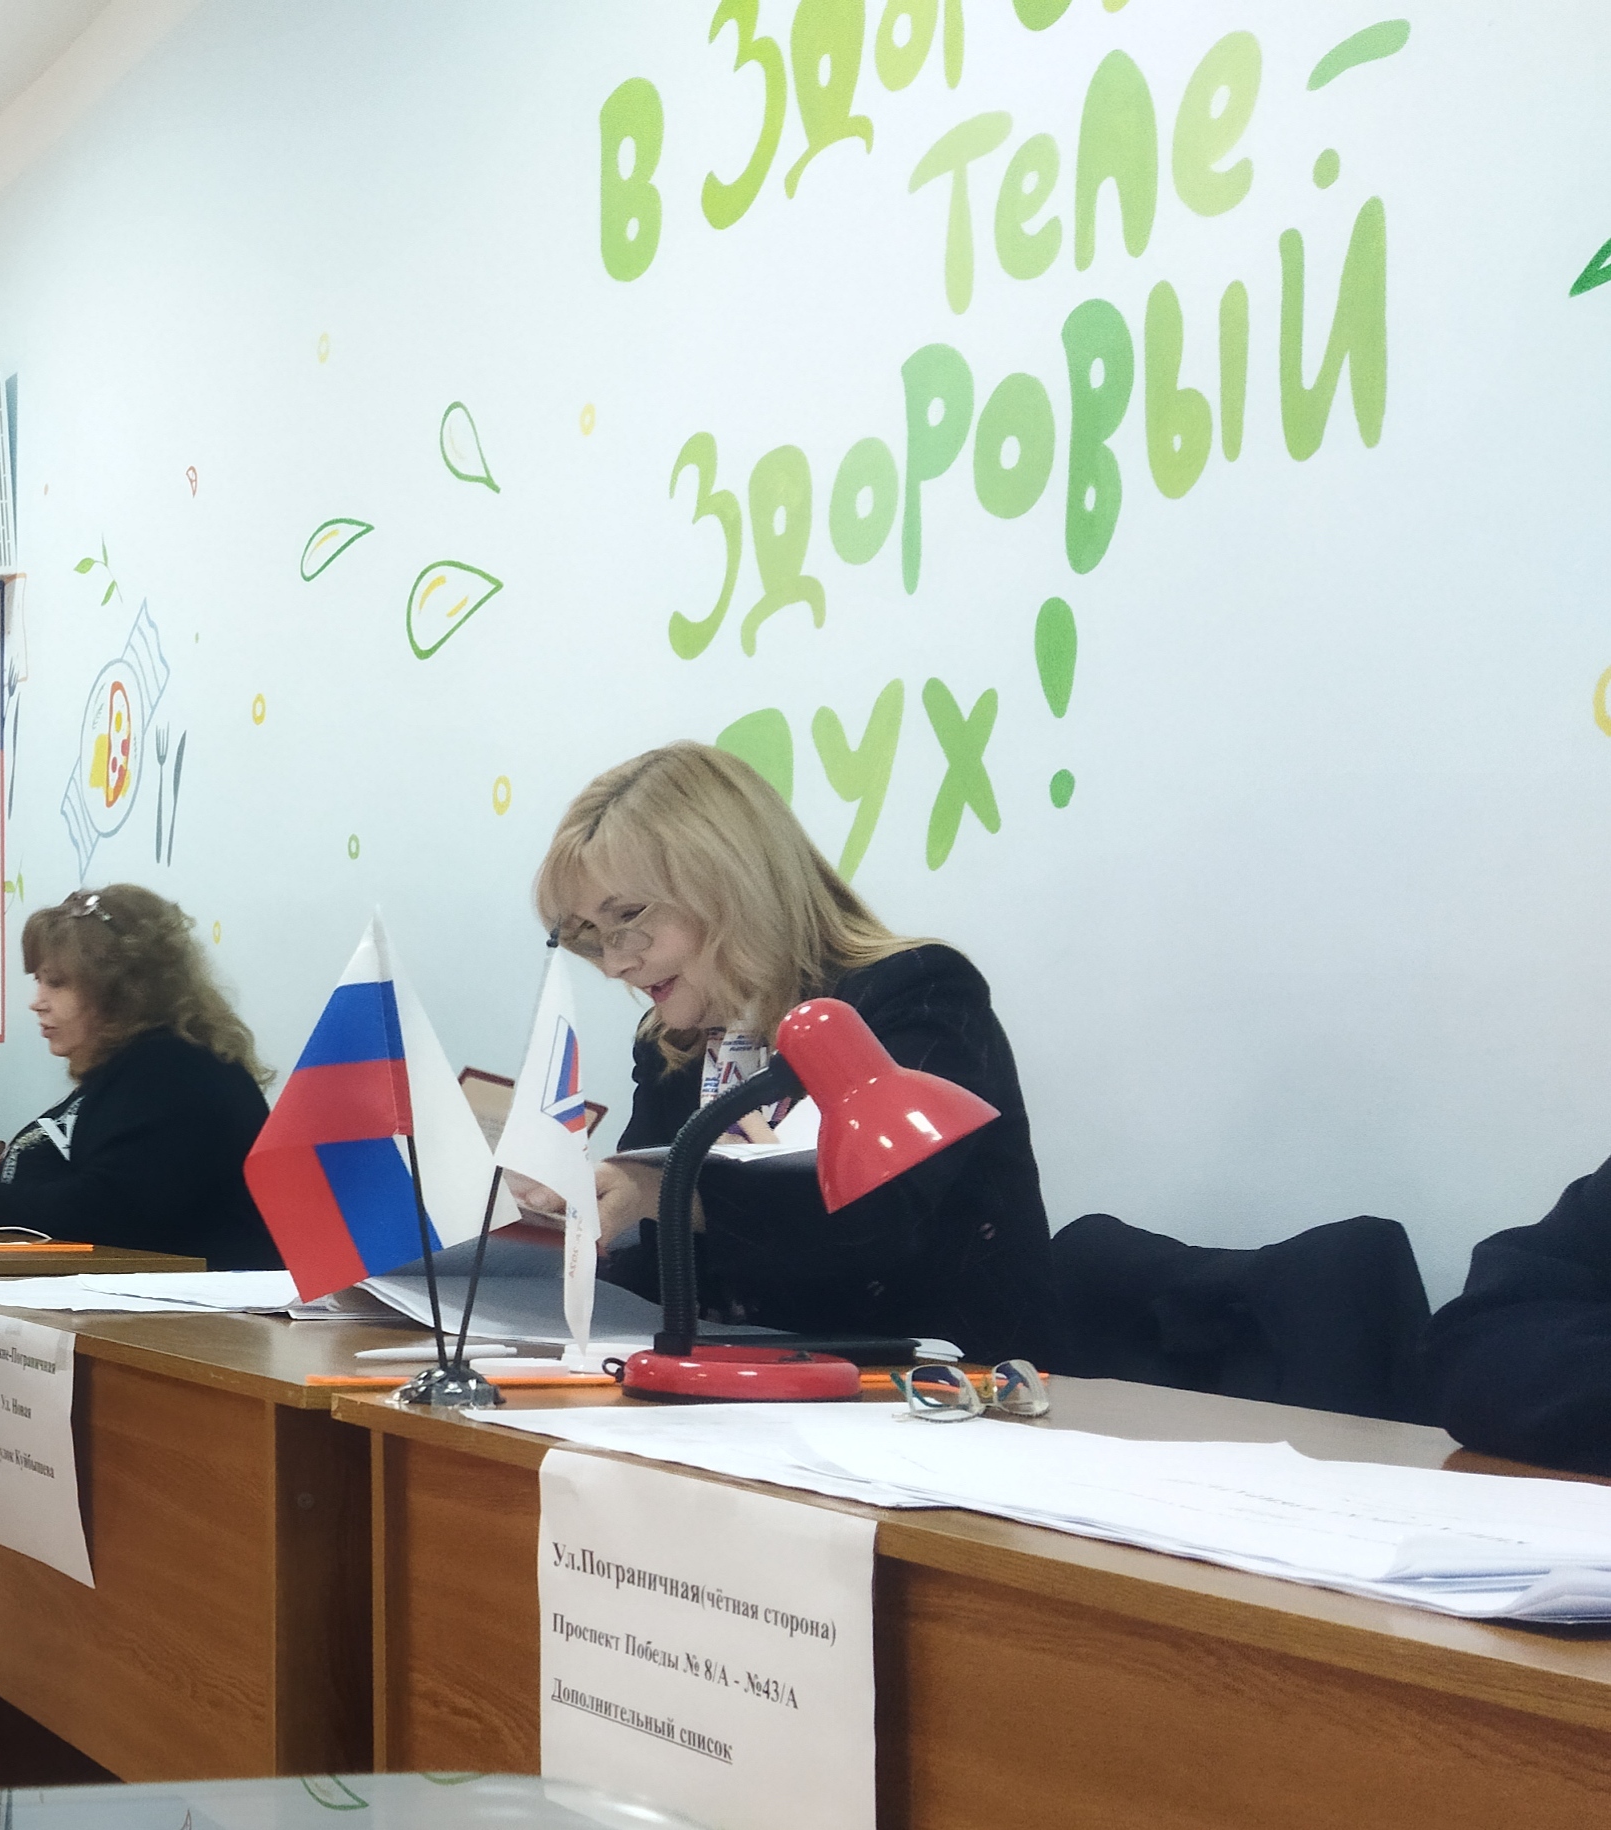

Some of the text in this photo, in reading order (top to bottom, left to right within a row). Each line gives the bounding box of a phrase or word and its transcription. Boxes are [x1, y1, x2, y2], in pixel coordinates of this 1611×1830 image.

[599, 77, 664, 282] В
[552, 1613, 621, 1651] Проспект
[625, 1633, 680, 1670] Победы
[683, 1652, 700, 1677] №
[764, 1607, 837, 1648] сторона)
[551, 1678, 733, 1764] Дополнительный список
